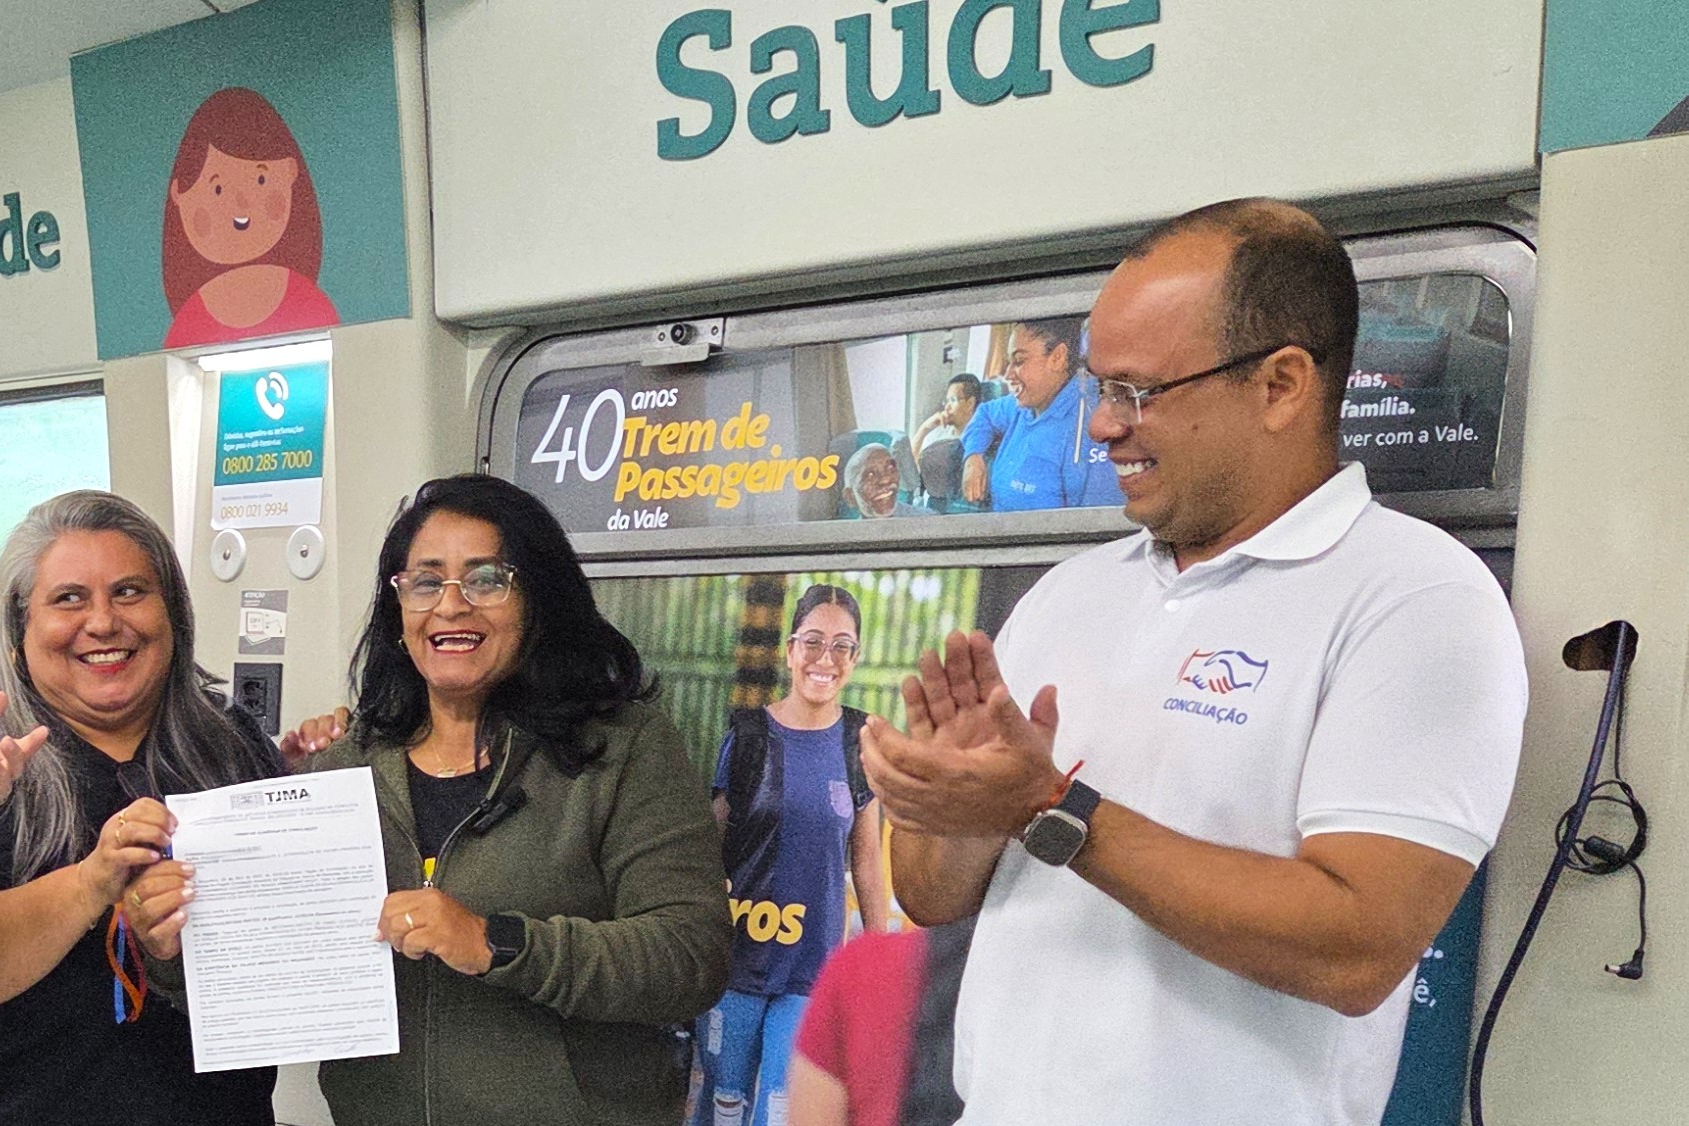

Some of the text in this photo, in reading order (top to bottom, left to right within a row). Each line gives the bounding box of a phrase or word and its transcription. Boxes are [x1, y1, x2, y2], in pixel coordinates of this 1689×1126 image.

[655, 0, 1161, 162] Saúde
[1346, 369, 1388, 390] rías,
[631, 387, 678, 411] anos
[1340, 396, 1416, 420] família.
[530, 388, 625, 486] 40
[622, 401, 768, 459] Trem de
[1343, 423, 1479, 447] ver com a Vale.
[222, 449, 313, 475] 0800 285 7000
[614, 443, 840, 511] Passageiros
[607, 509, 669, 531] da Vale
[1162, 697, 1248, 726] CONCILIAÇÃO
[265, 788, 311, 803] TJMA
[1413, 977, 1437, 1007] ê,
